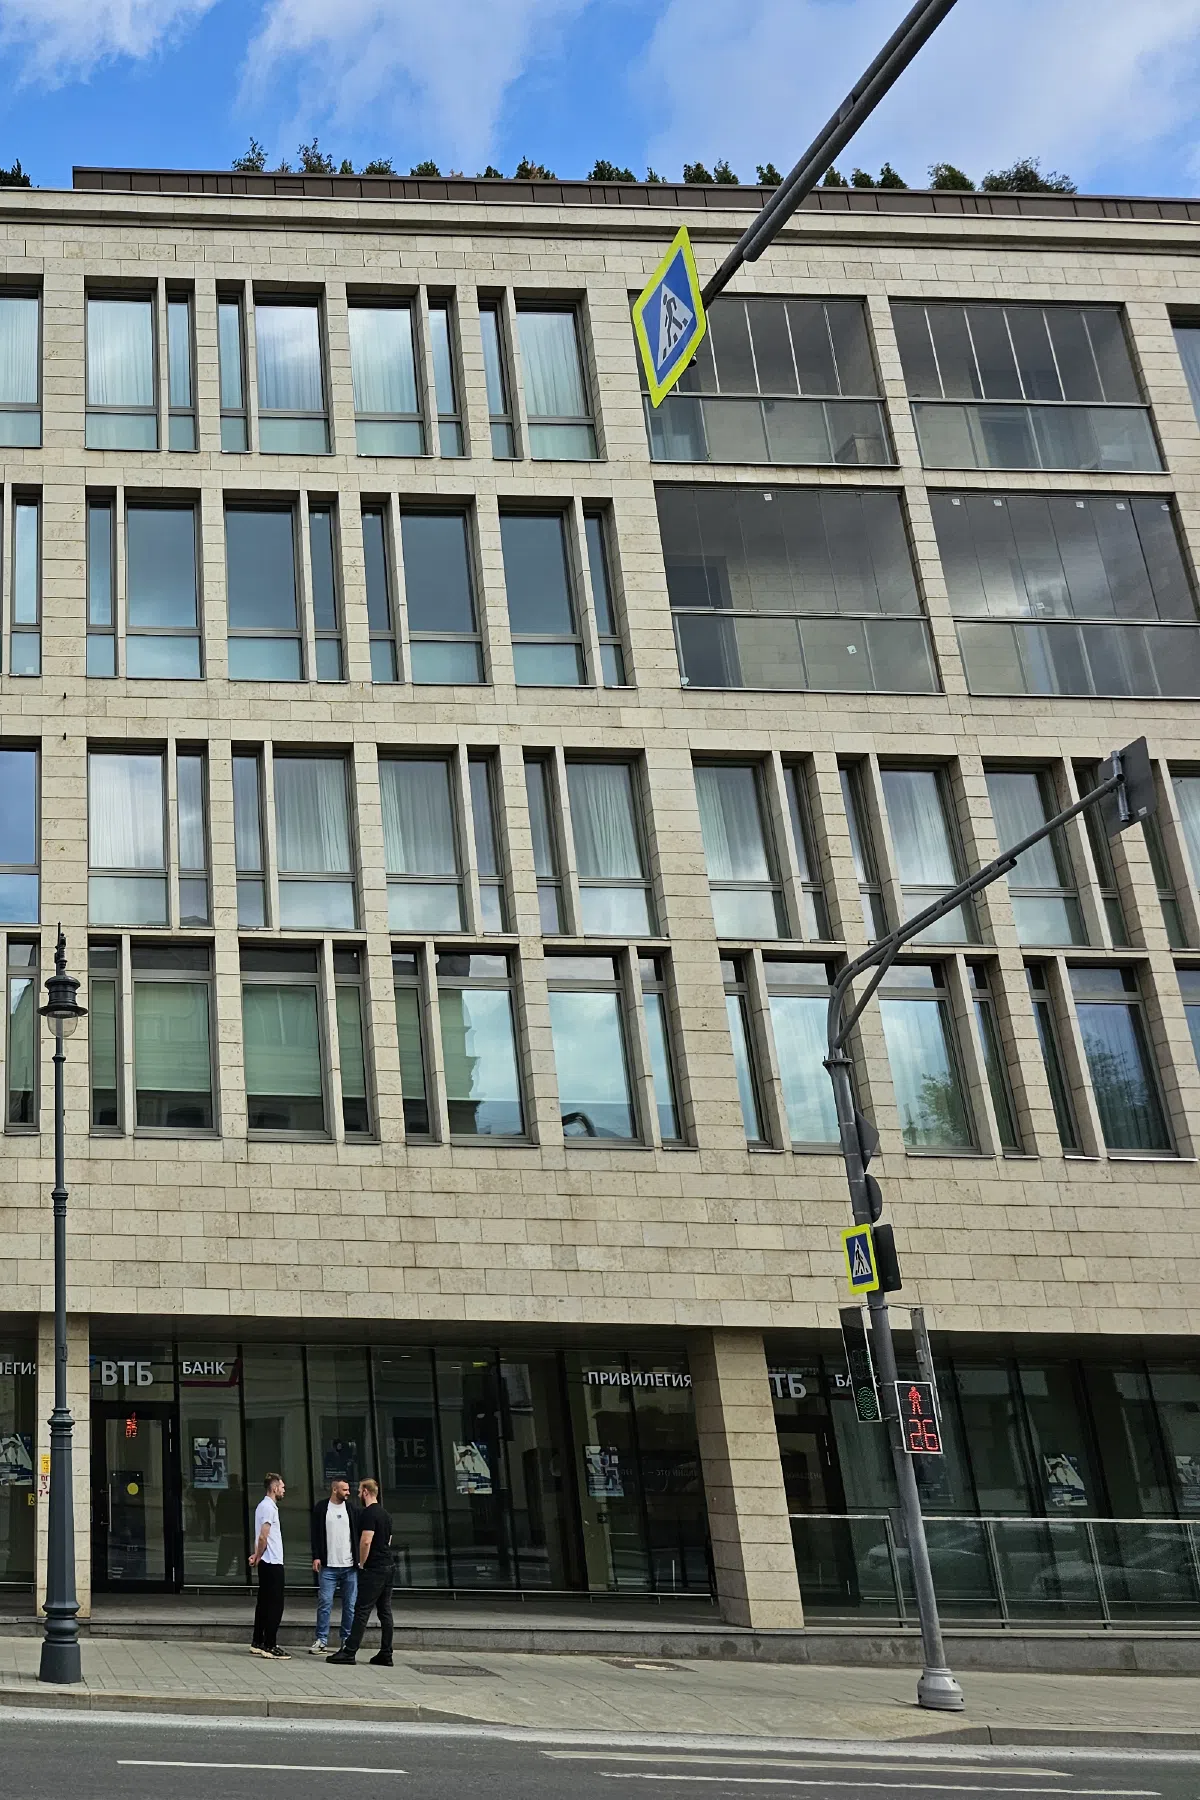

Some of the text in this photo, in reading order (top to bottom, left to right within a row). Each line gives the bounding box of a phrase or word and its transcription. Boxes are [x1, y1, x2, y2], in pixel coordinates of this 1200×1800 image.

[101, 1361, 226, 1386] ВТБ БАНК
[588, 1371, 692, 1387] ПРИВИЛЕГИЯ
[768, 1373, 807, 1398] ТБ
[909, 1419, 939, 1450] 26
